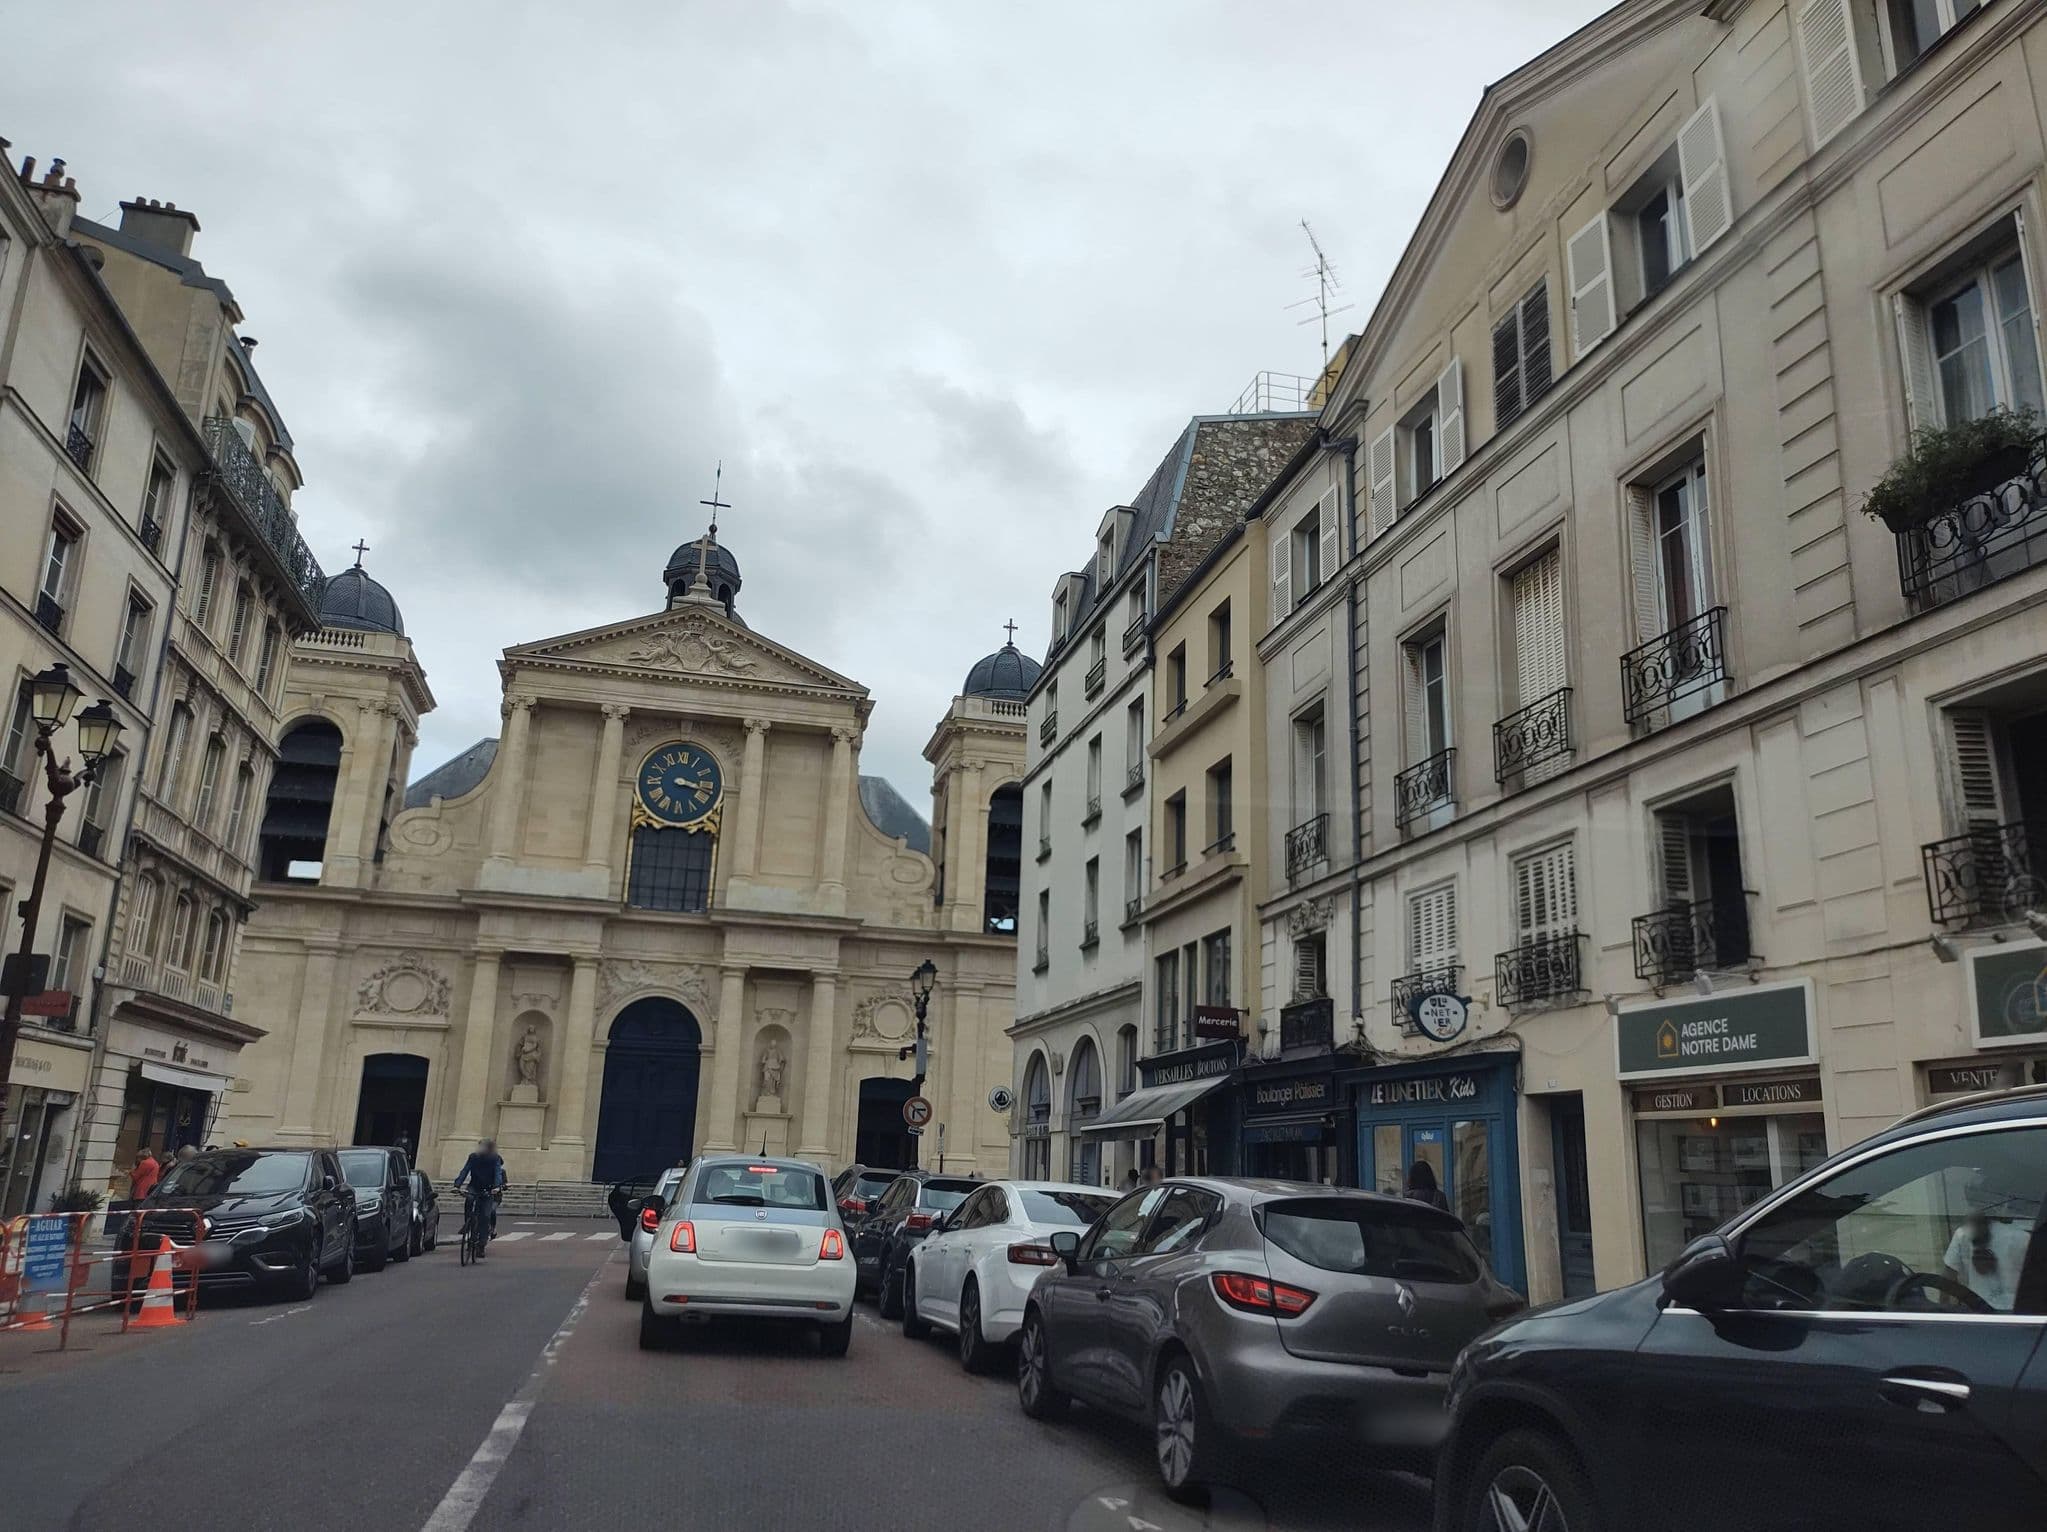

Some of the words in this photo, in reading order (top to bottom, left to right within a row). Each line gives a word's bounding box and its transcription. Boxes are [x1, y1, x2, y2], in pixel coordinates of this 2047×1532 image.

[1198, 1015, 1237, 1026] Mercerie
[1681, 1018, 1728, 1038] AGENCE
[1681, 1039, 1719, 1056] NOTRE
[1722, 1033, 1757, 1052] DAME
[1154, 1063, 1193, 1084] VERSAILLES
[1198, 1058, 1227, 1076] BOUTONS
[1256, 1086, 1293, 1106] Boulanger
[1385, 1080, 1448, 1103] LUNETIER
[1450, 1077, 1476, 1099] Kids
[1742, 1084, 1801, 1102] LOCATIONS
[1655, 1093, 1693, 1109] GESTION
